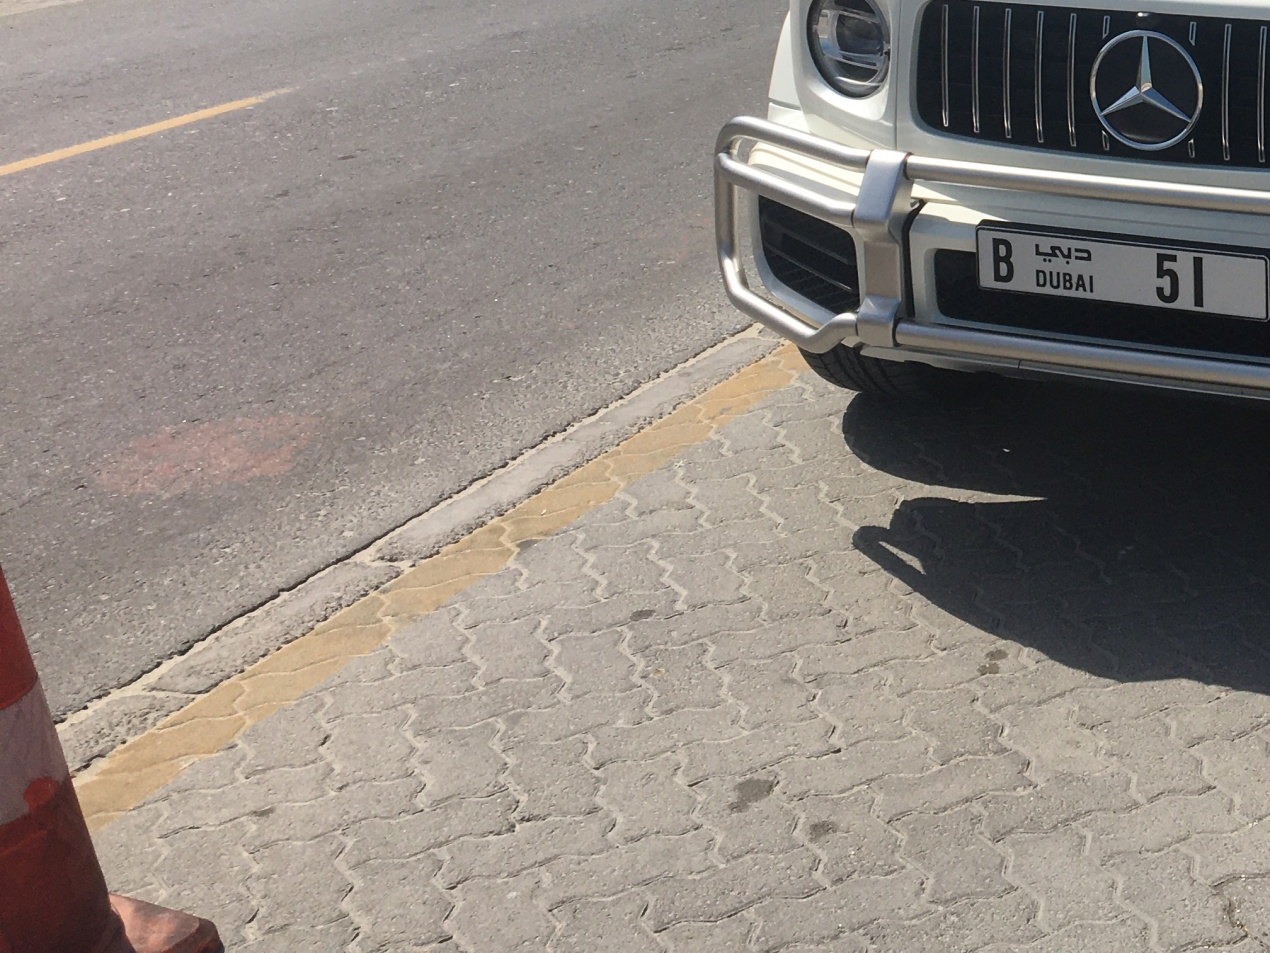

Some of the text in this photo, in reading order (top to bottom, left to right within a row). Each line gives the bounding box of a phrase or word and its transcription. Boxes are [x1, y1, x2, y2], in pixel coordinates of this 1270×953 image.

[1035, 243, 1092, 265] دبي
[992, 237, 1204, 308] B 51
[1035, 269, 1094, 294] DUBAI
